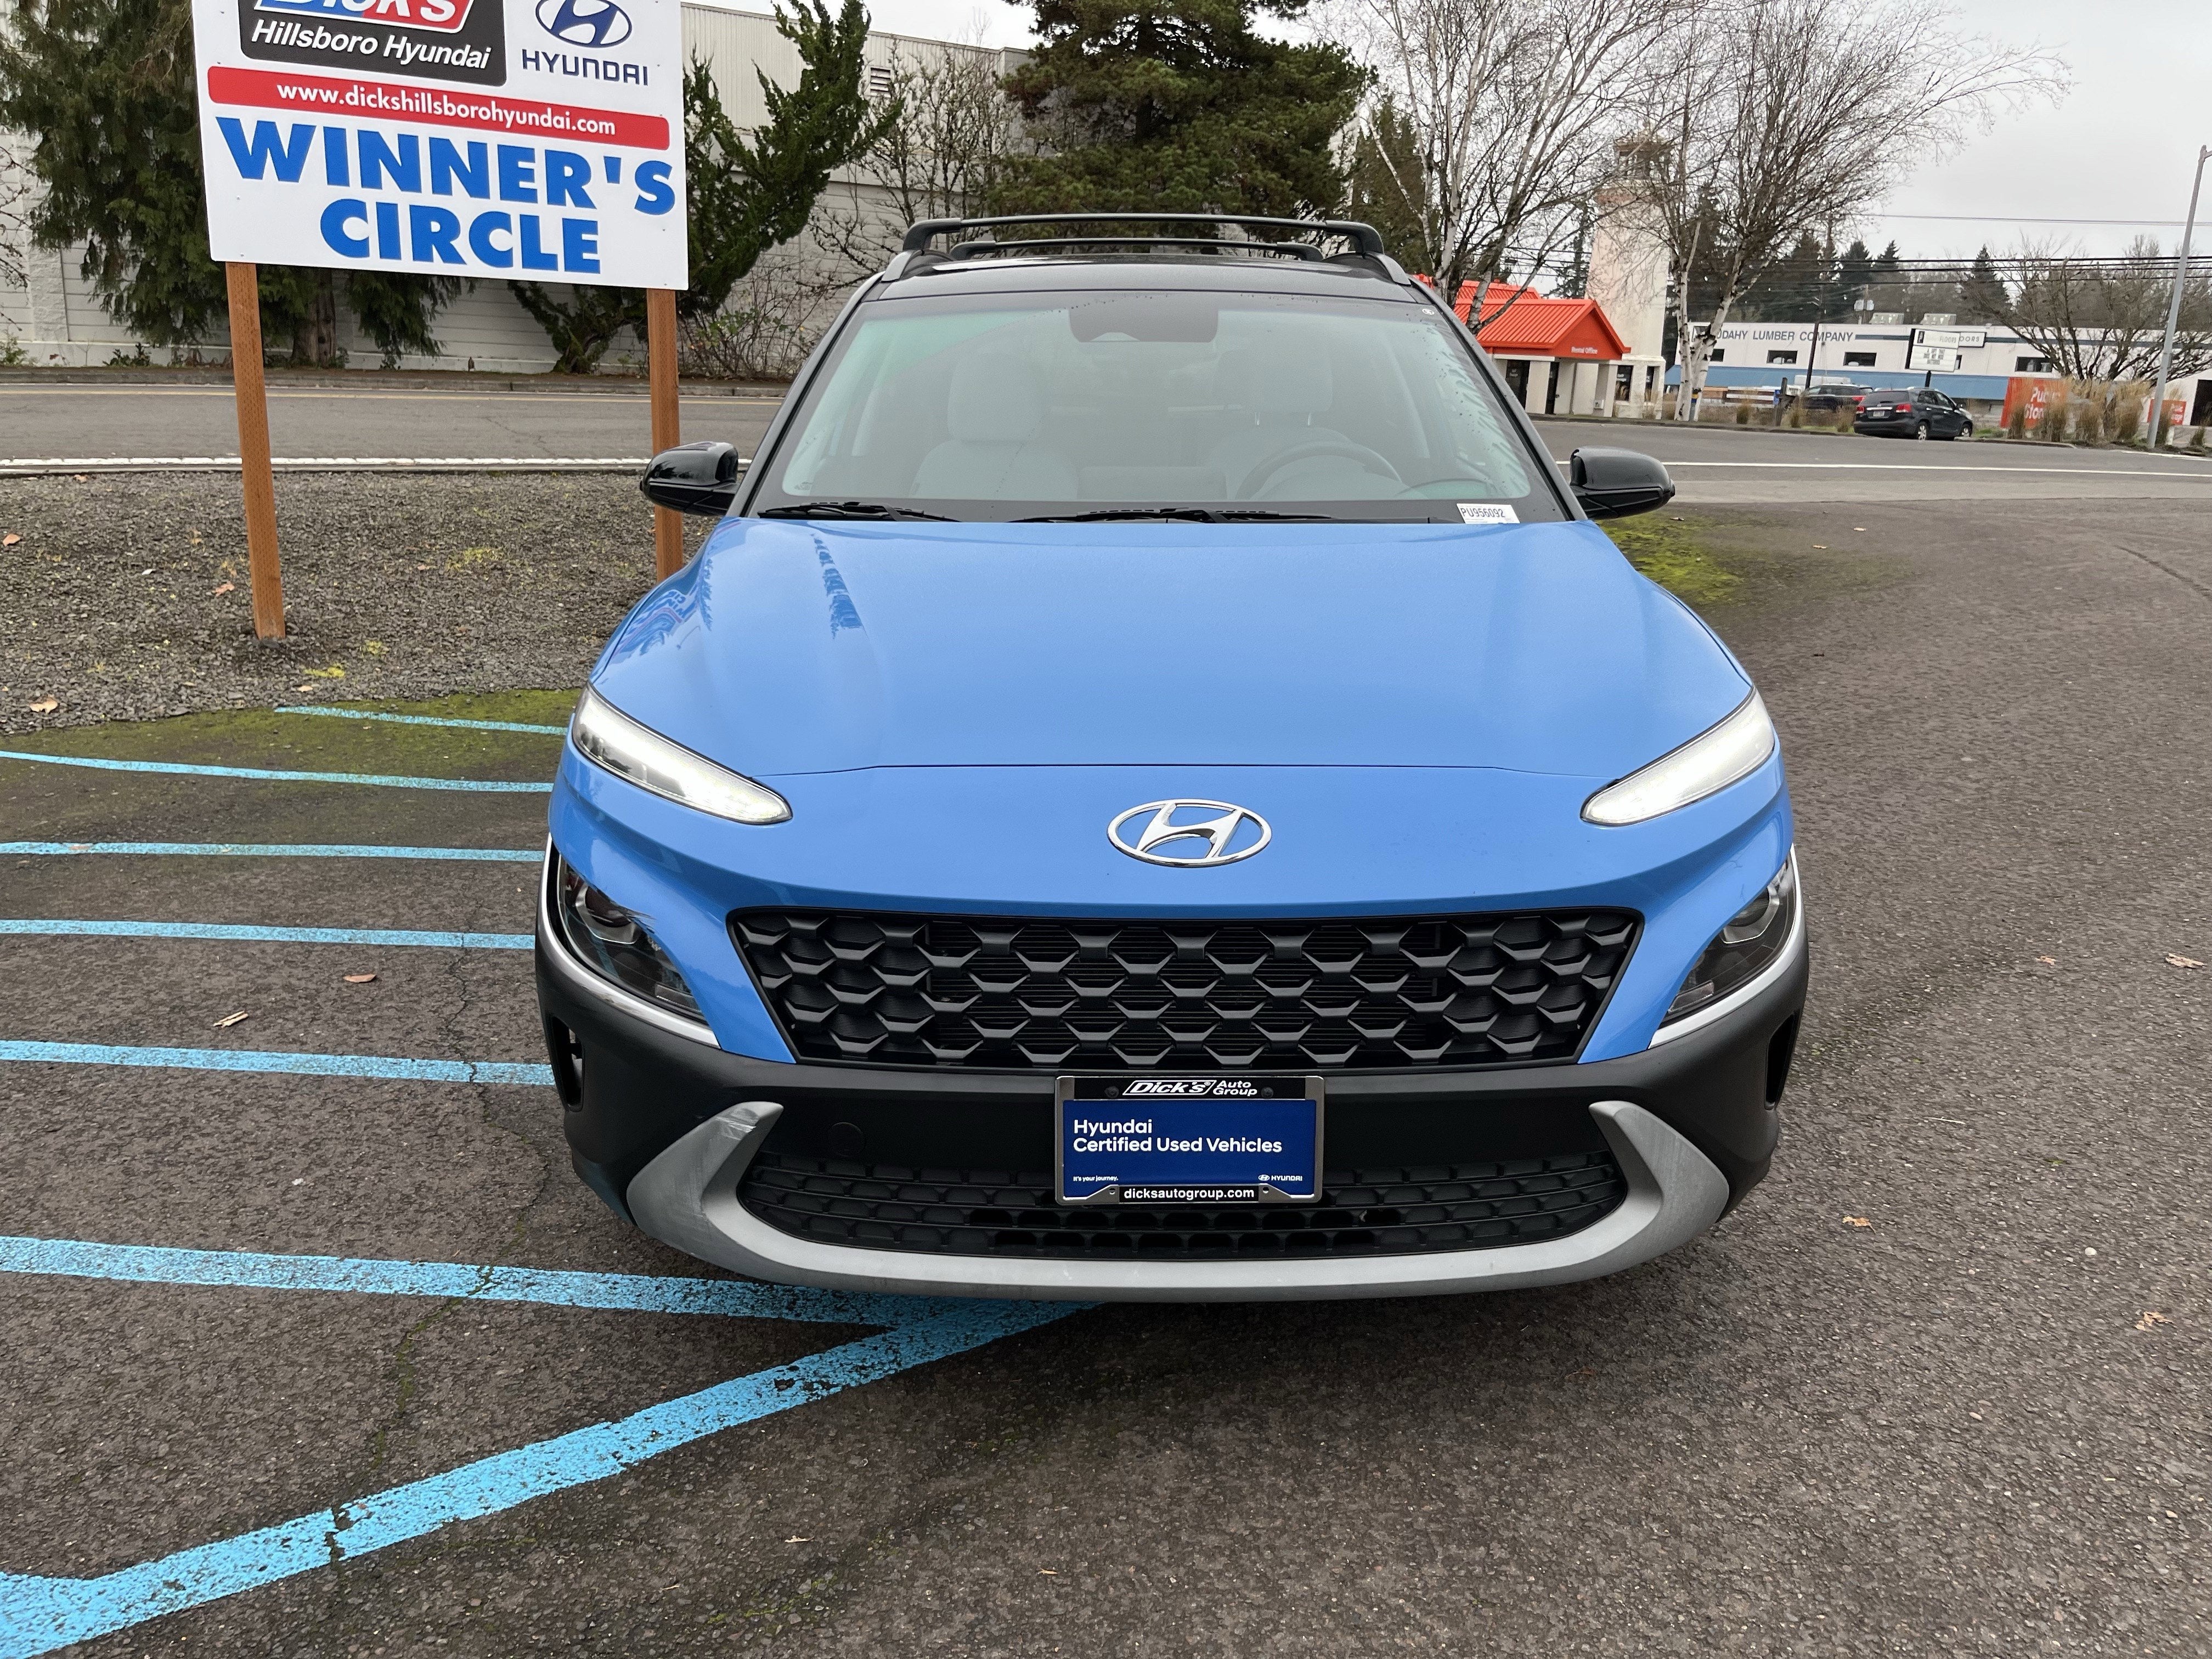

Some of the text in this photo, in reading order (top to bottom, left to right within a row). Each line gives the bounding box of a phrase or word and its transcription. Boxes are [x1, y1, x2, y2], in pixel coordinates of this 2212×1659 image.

[251, 19, 492, 69] Hillsboro Hyundai
[522, 49, 648, 86] HYUNDAI
[276, 81, 616, 136] www.dickshillsborohyundai.com
[216, 116, 675, 216] WINNER'S
[320, 198, 601, 274] CIRCLE
[1753, 330, 1795, 341] LUMBER
[1799, 331, 1853, 342] COMPANY
[1460, 507, 1505, 518] PU956092
[1130, 1080, 1251, 1093] Dick's Auto
[1212, 1087, 1258, 1097] Group
[1074, 1119, 1152, 1137] Hyundai
[1073, 1137, 1283, 1153] Certified Used Vehicles
[1124, 1188, 1255, 1201] dicksautogroup.com
